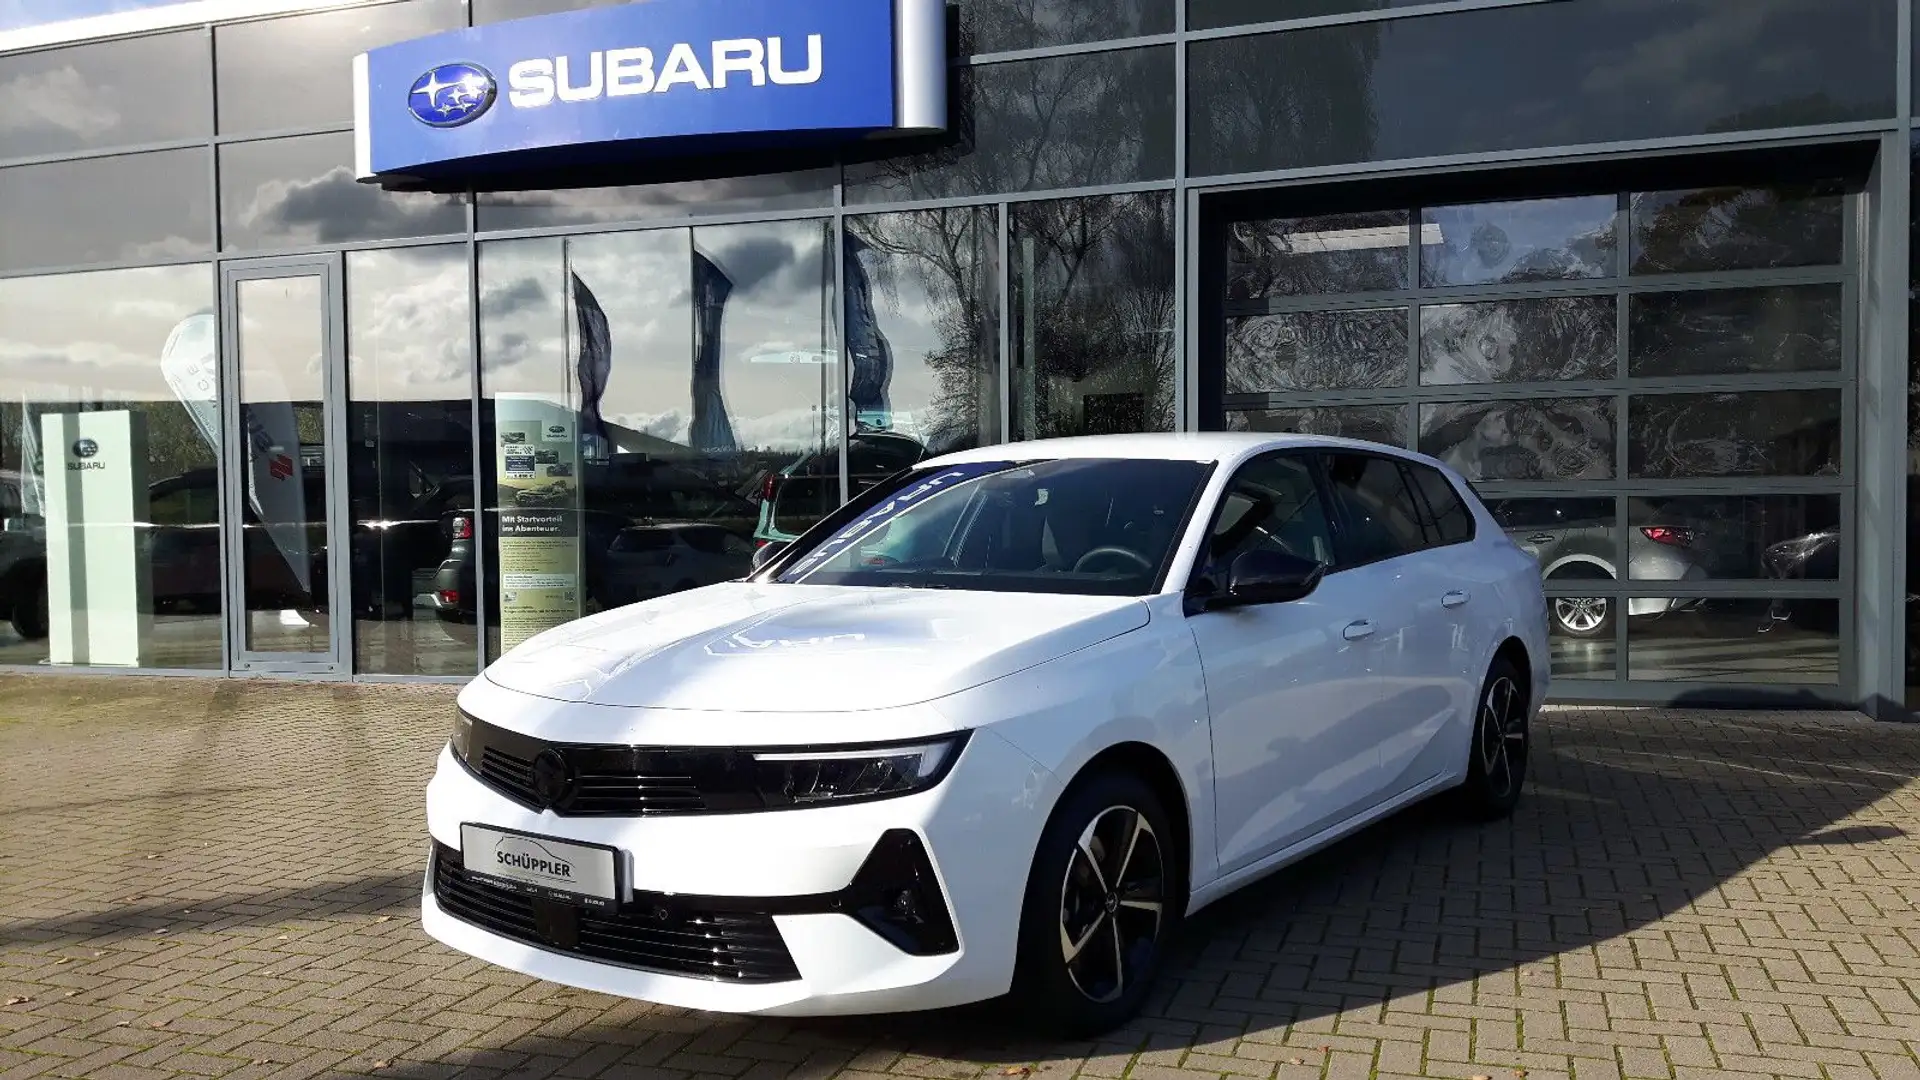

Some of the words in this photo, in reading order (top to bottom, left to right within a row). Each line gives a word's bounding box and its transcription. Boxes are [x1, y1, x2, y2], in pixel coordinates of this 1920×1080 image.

[507, 33, 823, 109] SUBARU
[67, 461, 106, 471] SUBARU
[501, 515, 515, 523] Mit
[516, 515, 563, 523] Startvorteil
[496, 850, 572, 878] SCHÜPPLER
